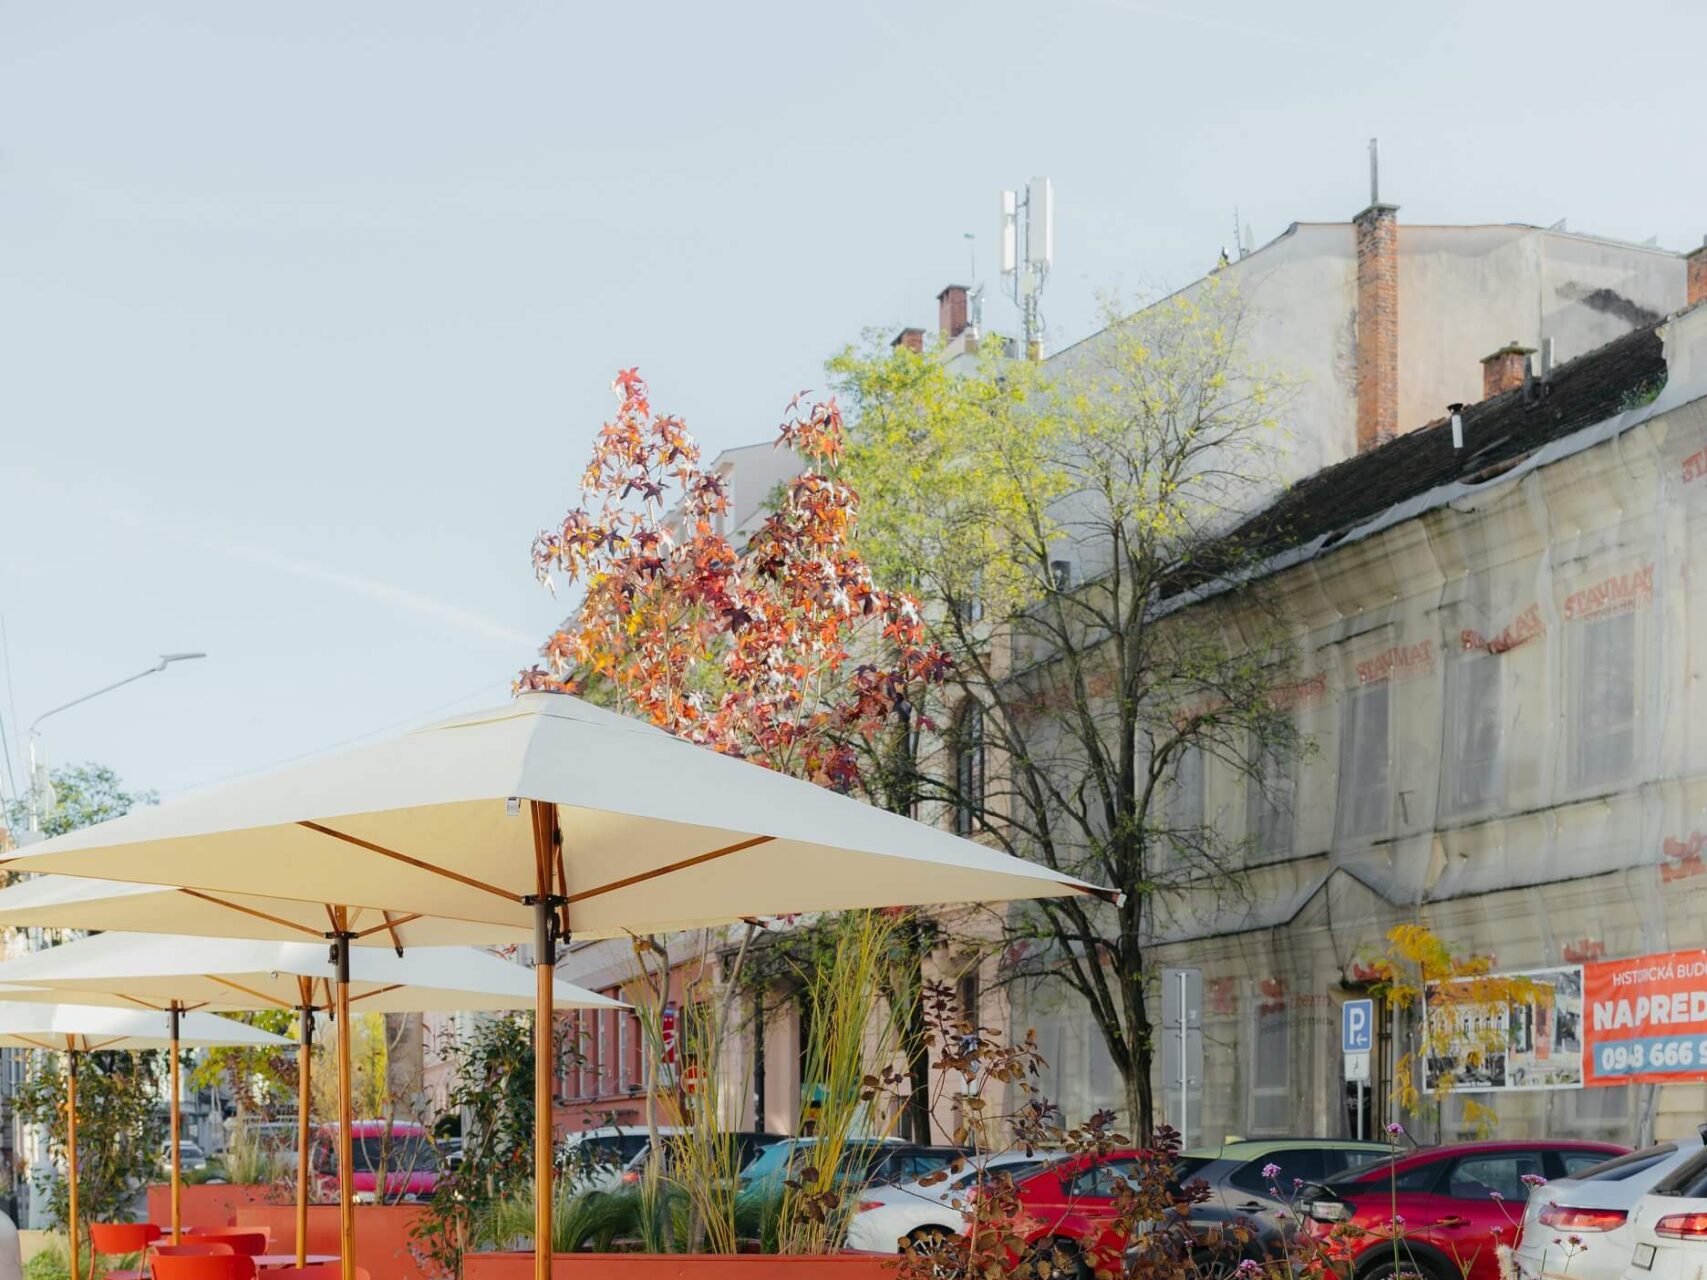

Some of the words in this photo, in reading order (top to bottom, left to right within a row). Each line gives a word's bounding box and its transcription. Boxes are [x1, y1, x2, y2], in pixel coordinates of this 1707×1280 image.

[1564, 563, 1655, 621] STAVMAT
[1461, 603, 1541, 653] STMAT
[1356, 639, 1432, 684] STAVMAT
[1349, 1007, 1366, 1045] P
[1593, 991, 1707, 1031] NAPRED
[1649, 1041, 1693, 1066] 666
